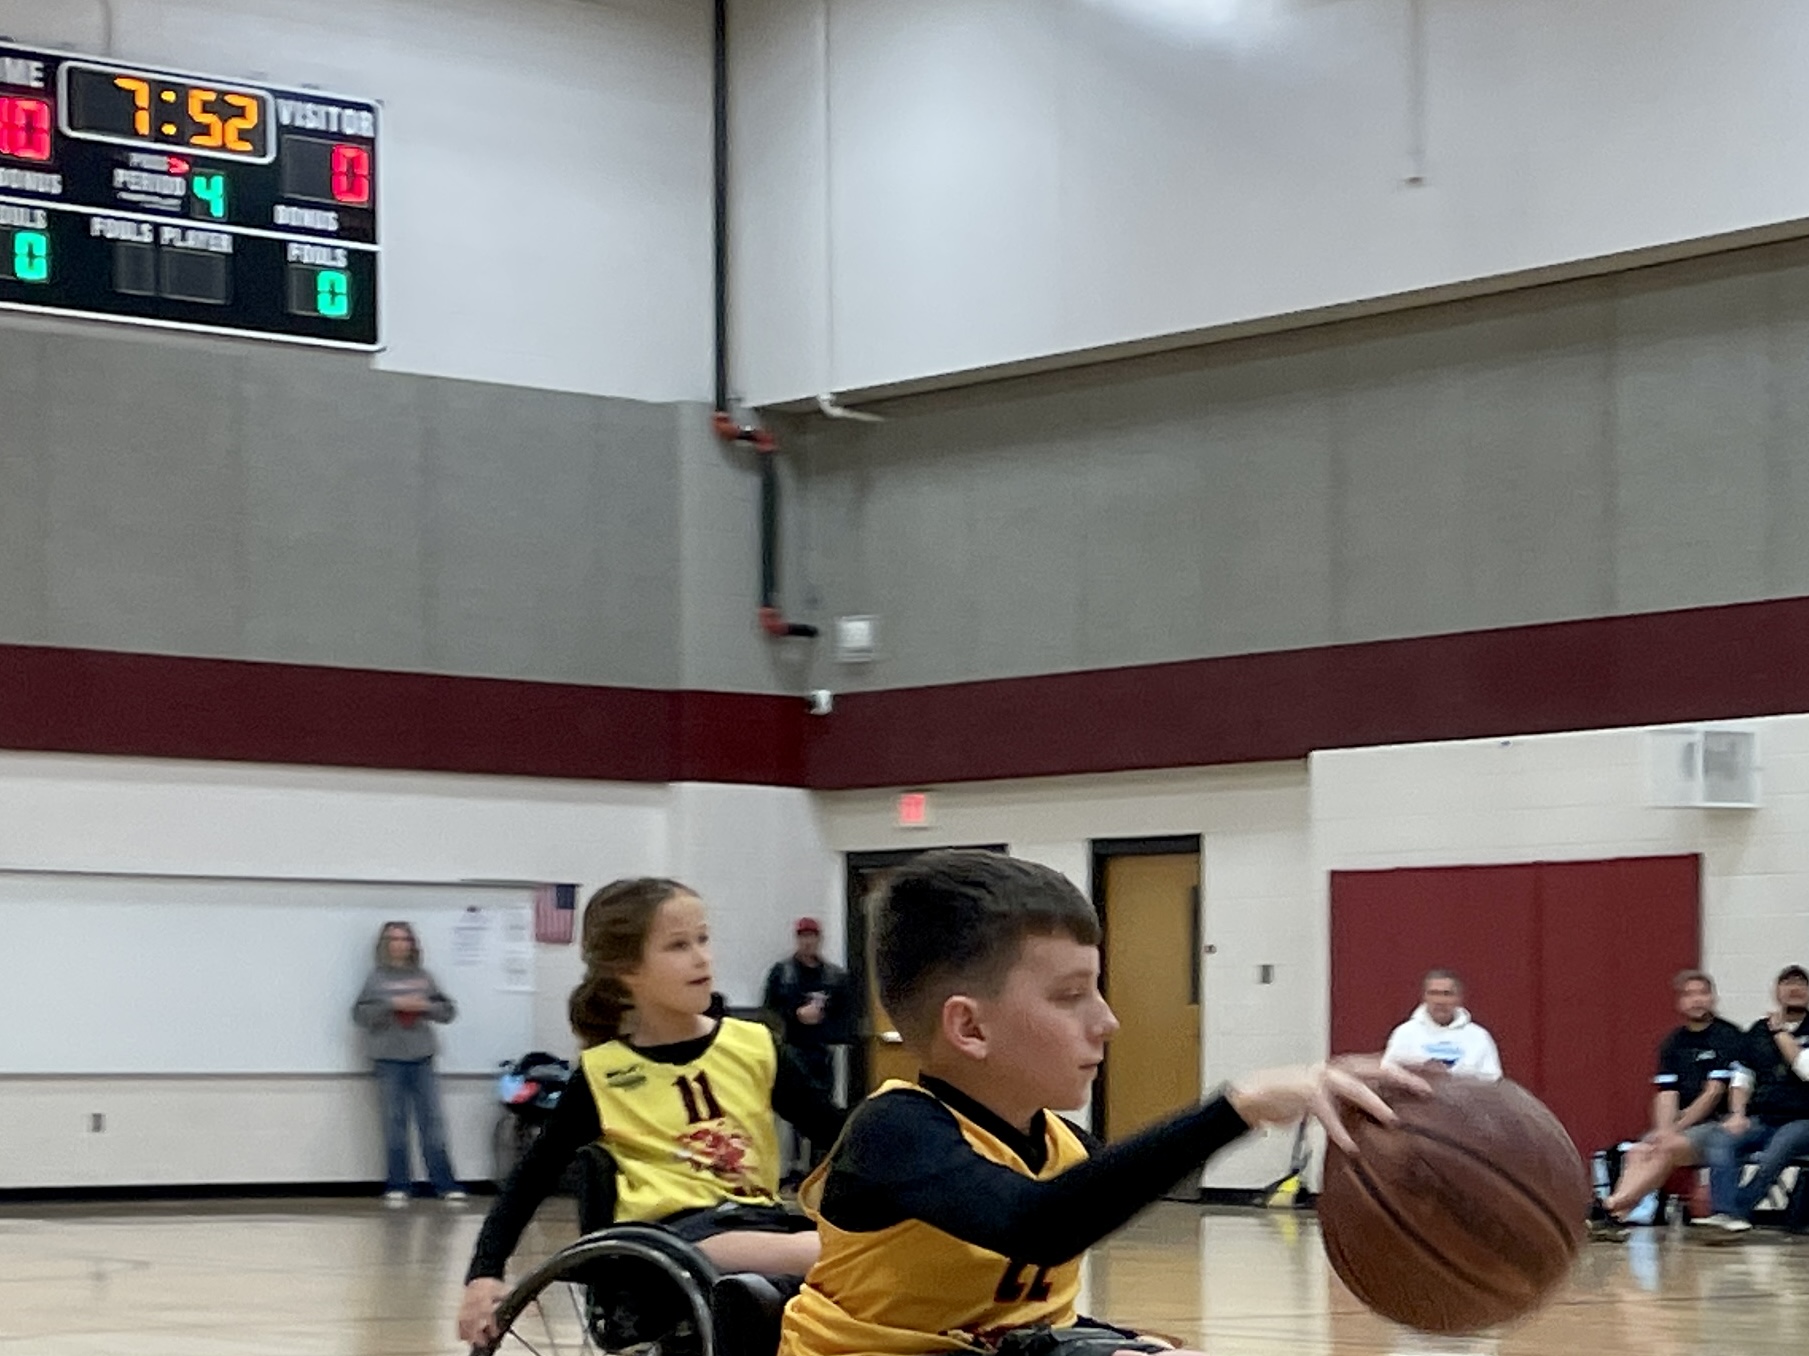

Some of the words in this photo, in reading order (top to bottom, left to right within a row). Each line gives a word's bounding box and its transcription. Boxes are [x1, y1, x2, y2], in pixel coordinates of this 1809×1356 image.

[113, 77, 258, 152] 7:52
[278, 100, 375, 137] VISITOR
[193, 175, 224, 218] 4
[331, 143, 370, 203] 0
[14, 231, 48, 281] 0
[159, 225, 234, 253] PLAYER
[316, 270, 349, 317] 0
[673, 1070, 724, 1124] 11
